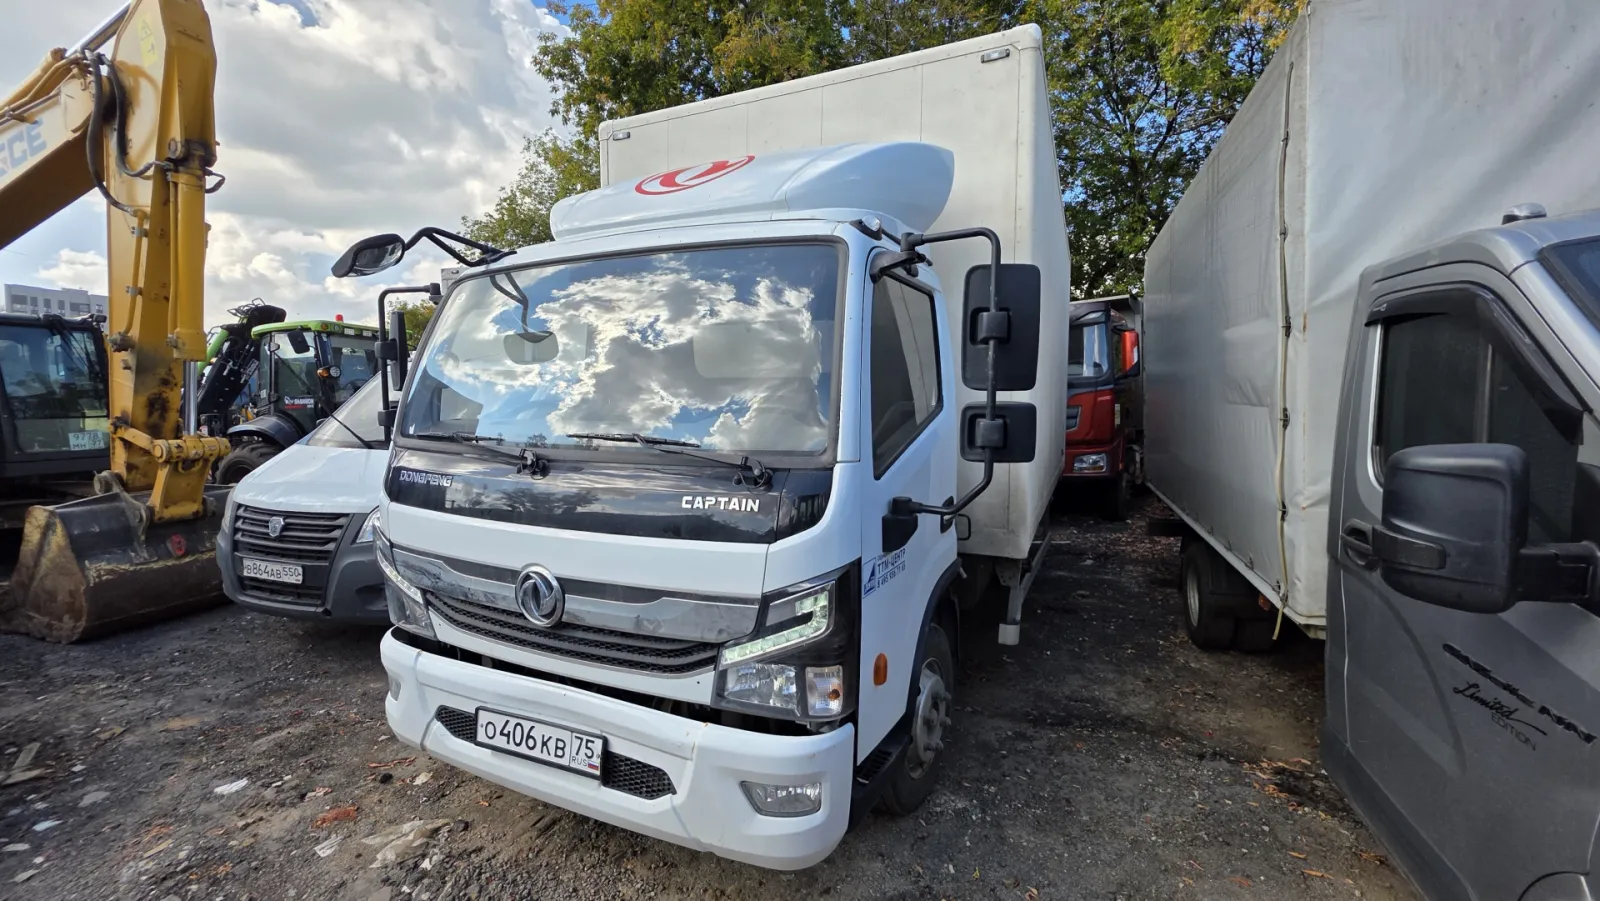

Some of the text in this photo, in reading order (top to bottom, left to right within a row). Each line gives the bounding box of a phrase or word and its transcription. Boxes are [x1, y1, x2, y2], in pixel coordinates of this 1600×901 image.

[399, 470, 453, 487] DONGFENG
[681, 495, 760, 513] CAPTAIN
[1453, 682, 1547, 736] Limited
[1491, 712, 1536, 752] EDITION
[574, 735, 595, 759] 75
[571, 755, 588, 767] RUS
